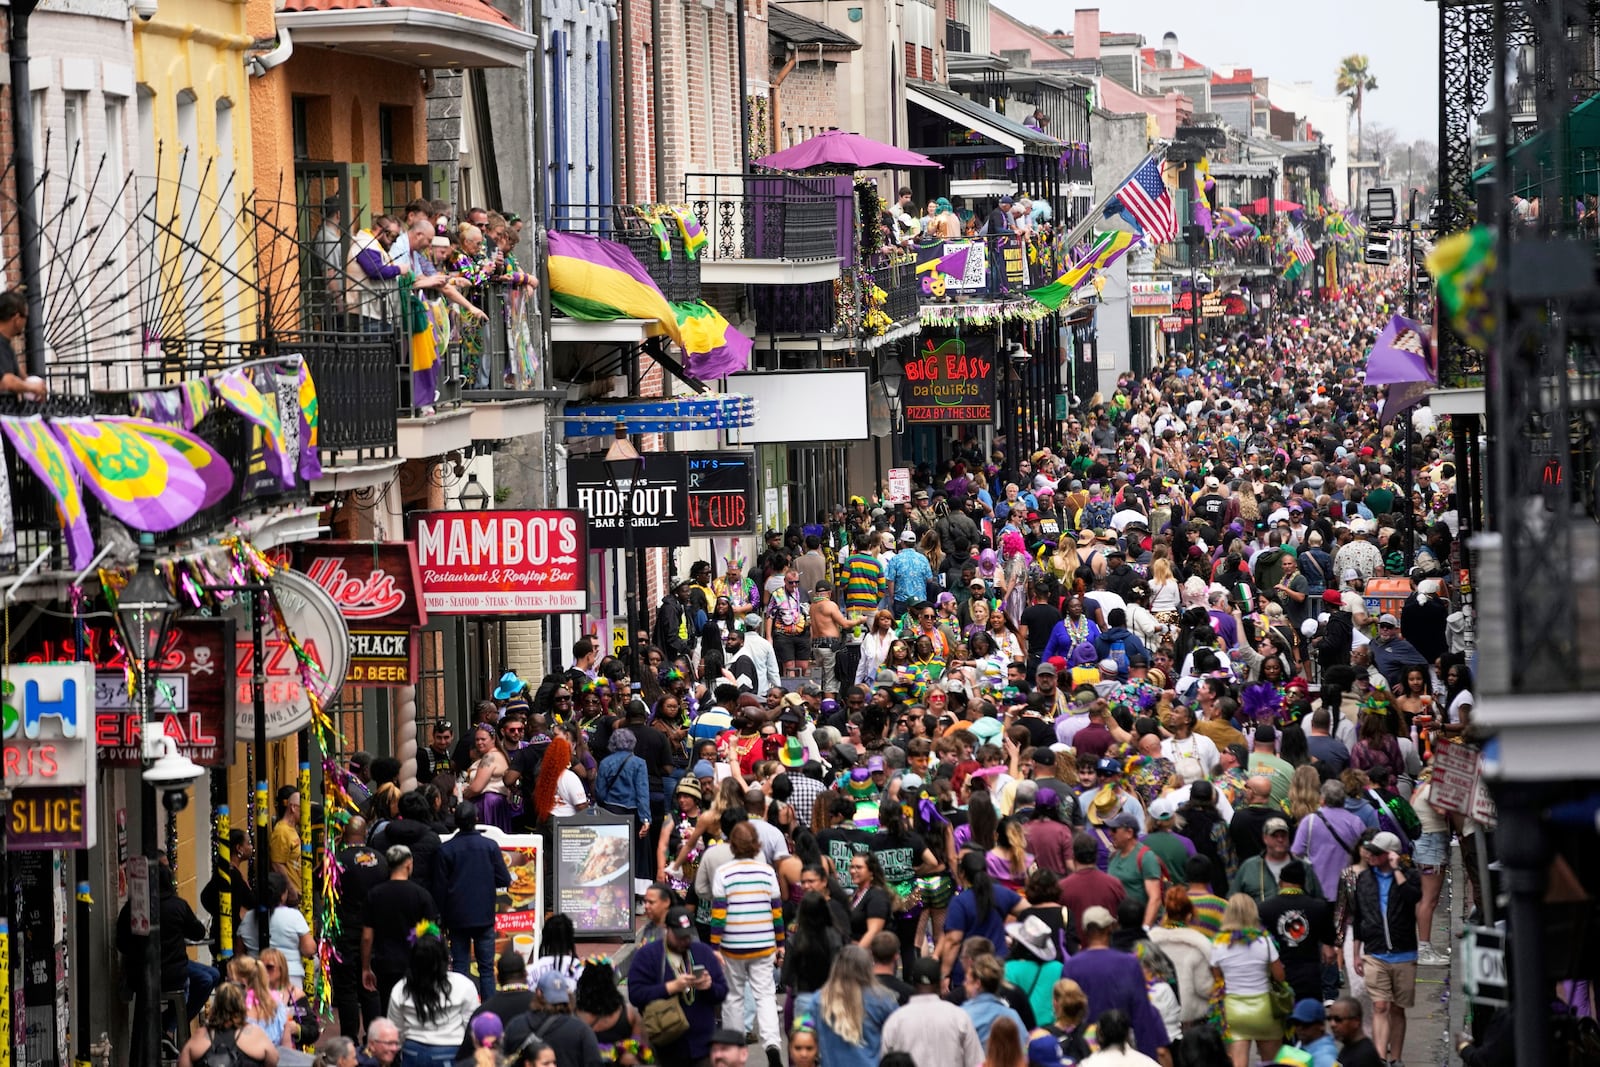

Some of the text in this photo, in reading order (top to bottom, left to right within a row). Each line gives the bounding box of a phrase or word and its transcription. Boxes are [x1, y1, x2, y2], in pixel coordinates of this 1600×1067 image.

[905, 353, 991, 380] BIG EASY
[907, 406, 991, 419] PIZZA BY THE SLICE
[595, 517, 660, 528] BAR & GRILL
[708, 495, 746, 528] CLUB
[418, 517, 577, 566] MAMBO'S
[424, 568, 575, 586] Restaurant & Rooftop Bar
[368, 666, 407, 681] BEER
[239, 681, 301, 705] BER
[3, 746, 58, 778] RIS
[110, 748, 141, 759] DYIN
[12, 799, 83, 834] SLICE
